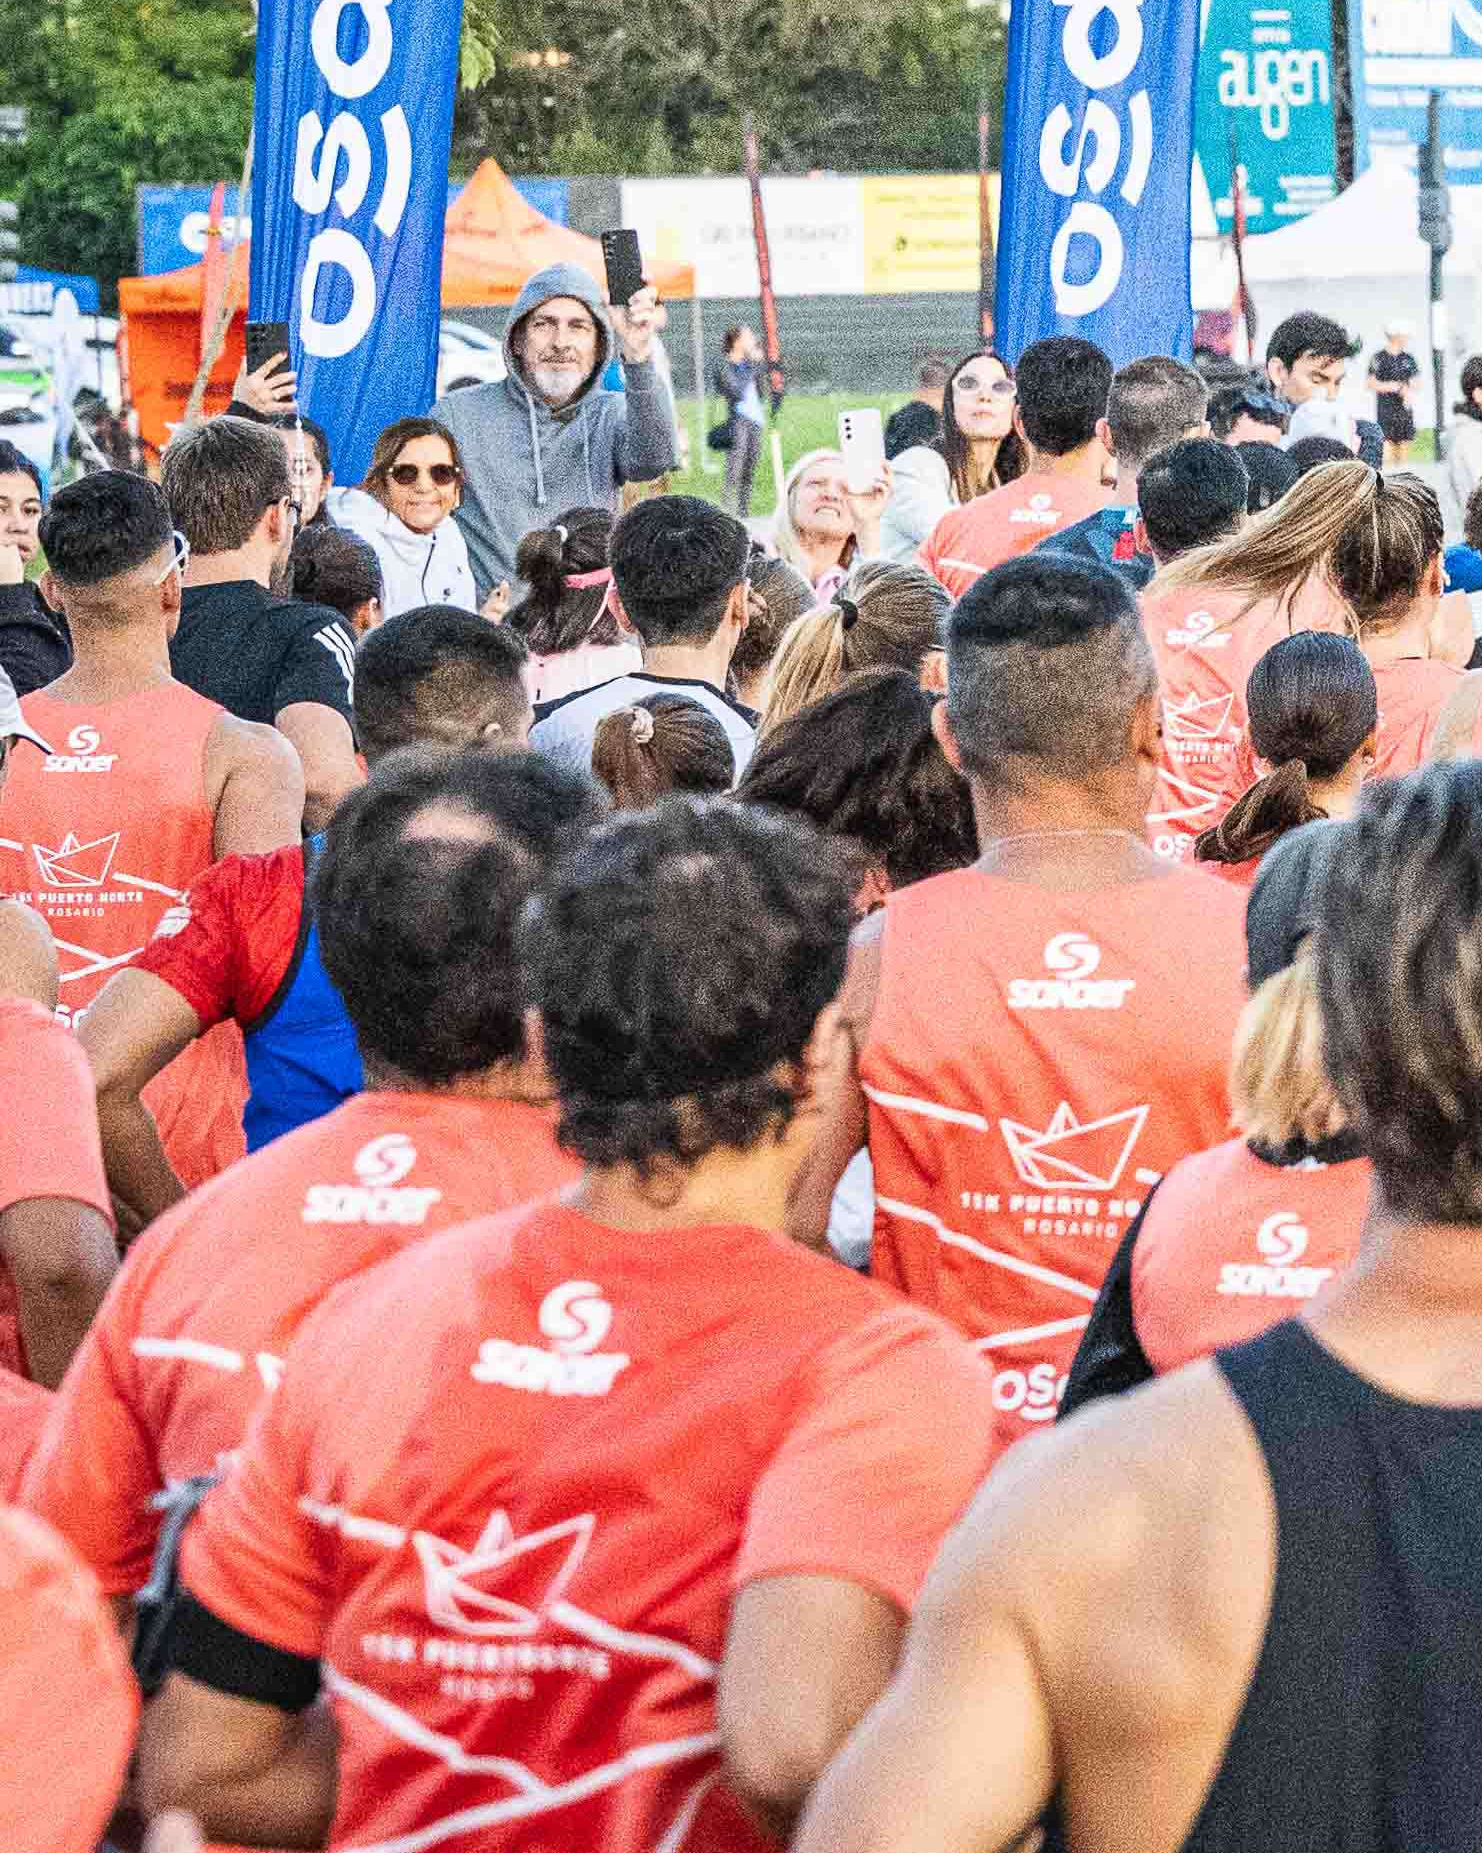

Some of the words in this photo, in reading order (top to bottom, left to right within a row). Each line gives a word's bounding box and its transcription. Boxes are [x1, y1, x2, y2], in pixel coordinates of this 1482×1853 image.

[1154, 835, 1190, 859] os
[1009, 1193, 1100, 1216] PUERTO
[1108, 1197, 1141, 1217] NO
[992, 1363, 1066, 1421] os
